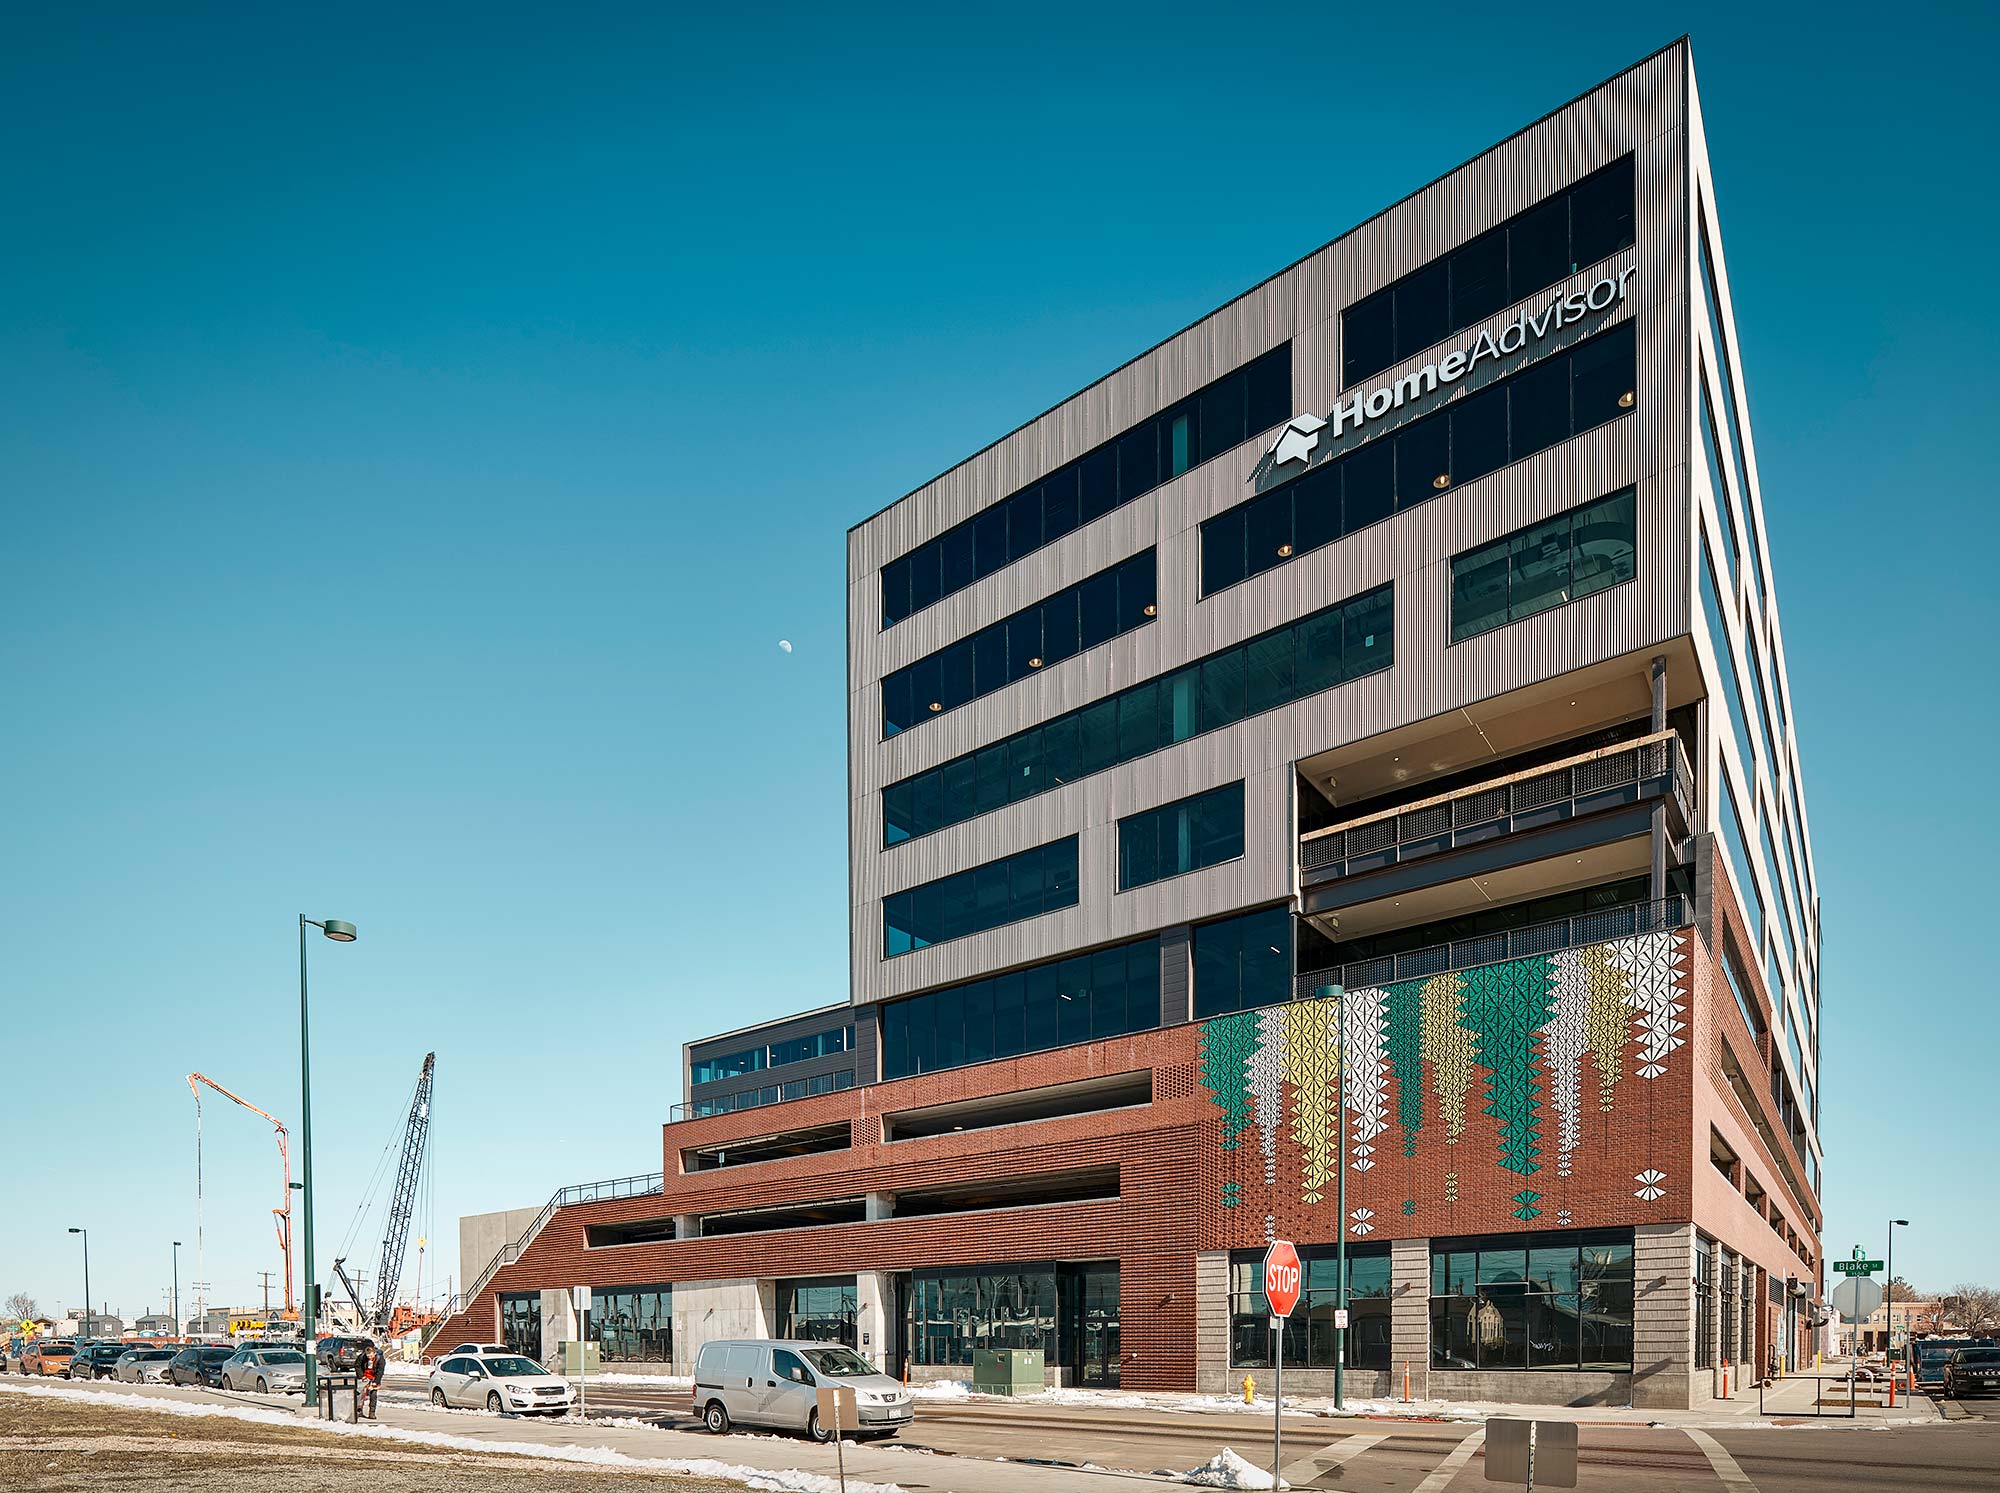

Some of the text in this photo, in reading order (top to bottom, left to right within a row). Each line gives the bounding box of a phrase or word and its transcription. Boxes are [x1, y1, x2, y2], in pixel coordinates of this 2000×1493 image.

[1333, 265, 1636, 438] HomeAdvisor
[1269, 1264, 1299, 1293] STOP
[1839, 1262, 1869, 1271] Blake
